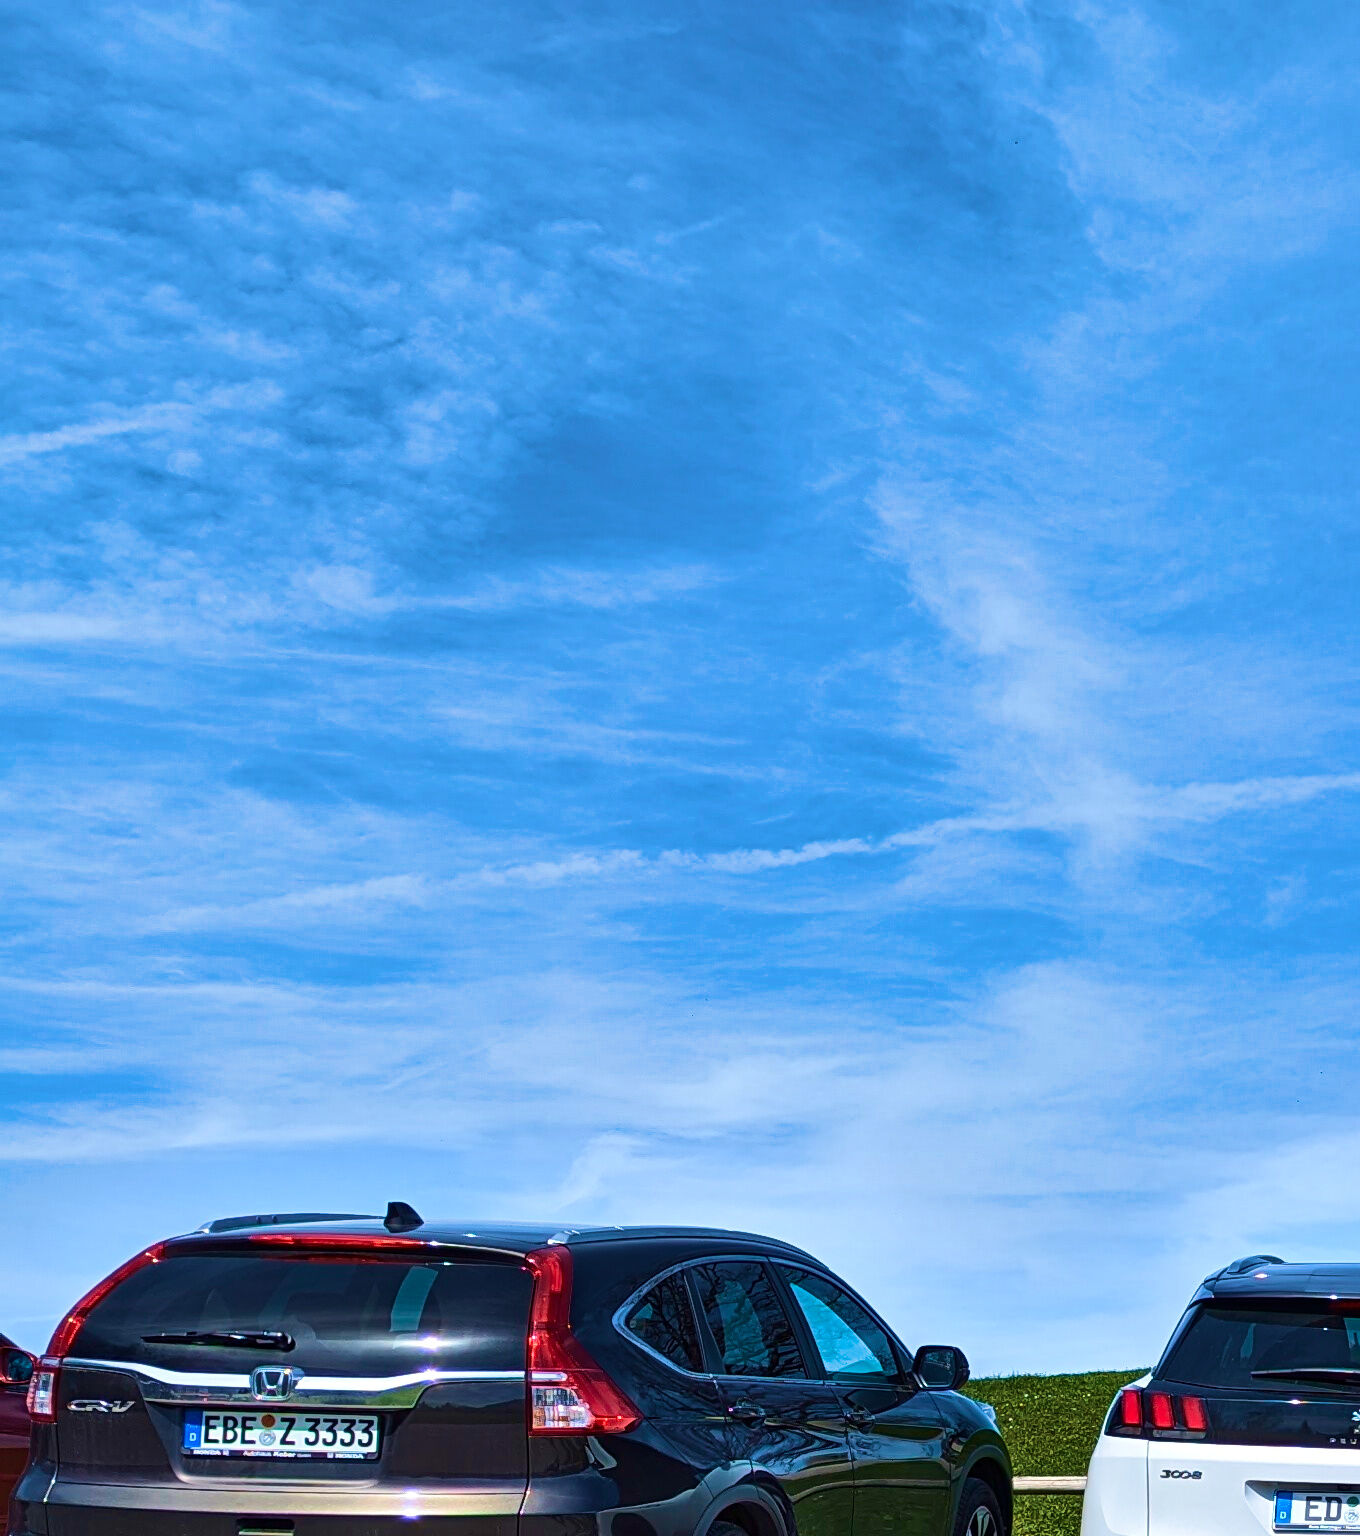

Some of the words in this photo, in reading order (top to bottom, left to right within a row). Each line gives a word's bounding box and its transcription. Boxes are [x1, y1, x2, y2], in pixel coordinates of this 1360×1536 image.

[203, 1415, 257, 1444] EBE
[279, 1417, 296, 1446] Z
[304, 1417, 375, 1447] 3333
[189, 1432, 197, 1442] D
[1160, 1469, 1203, 1480] 3008
[1304, 1496, 1343, 1522] ED
[1279, 1511, 1287, 1520] D
